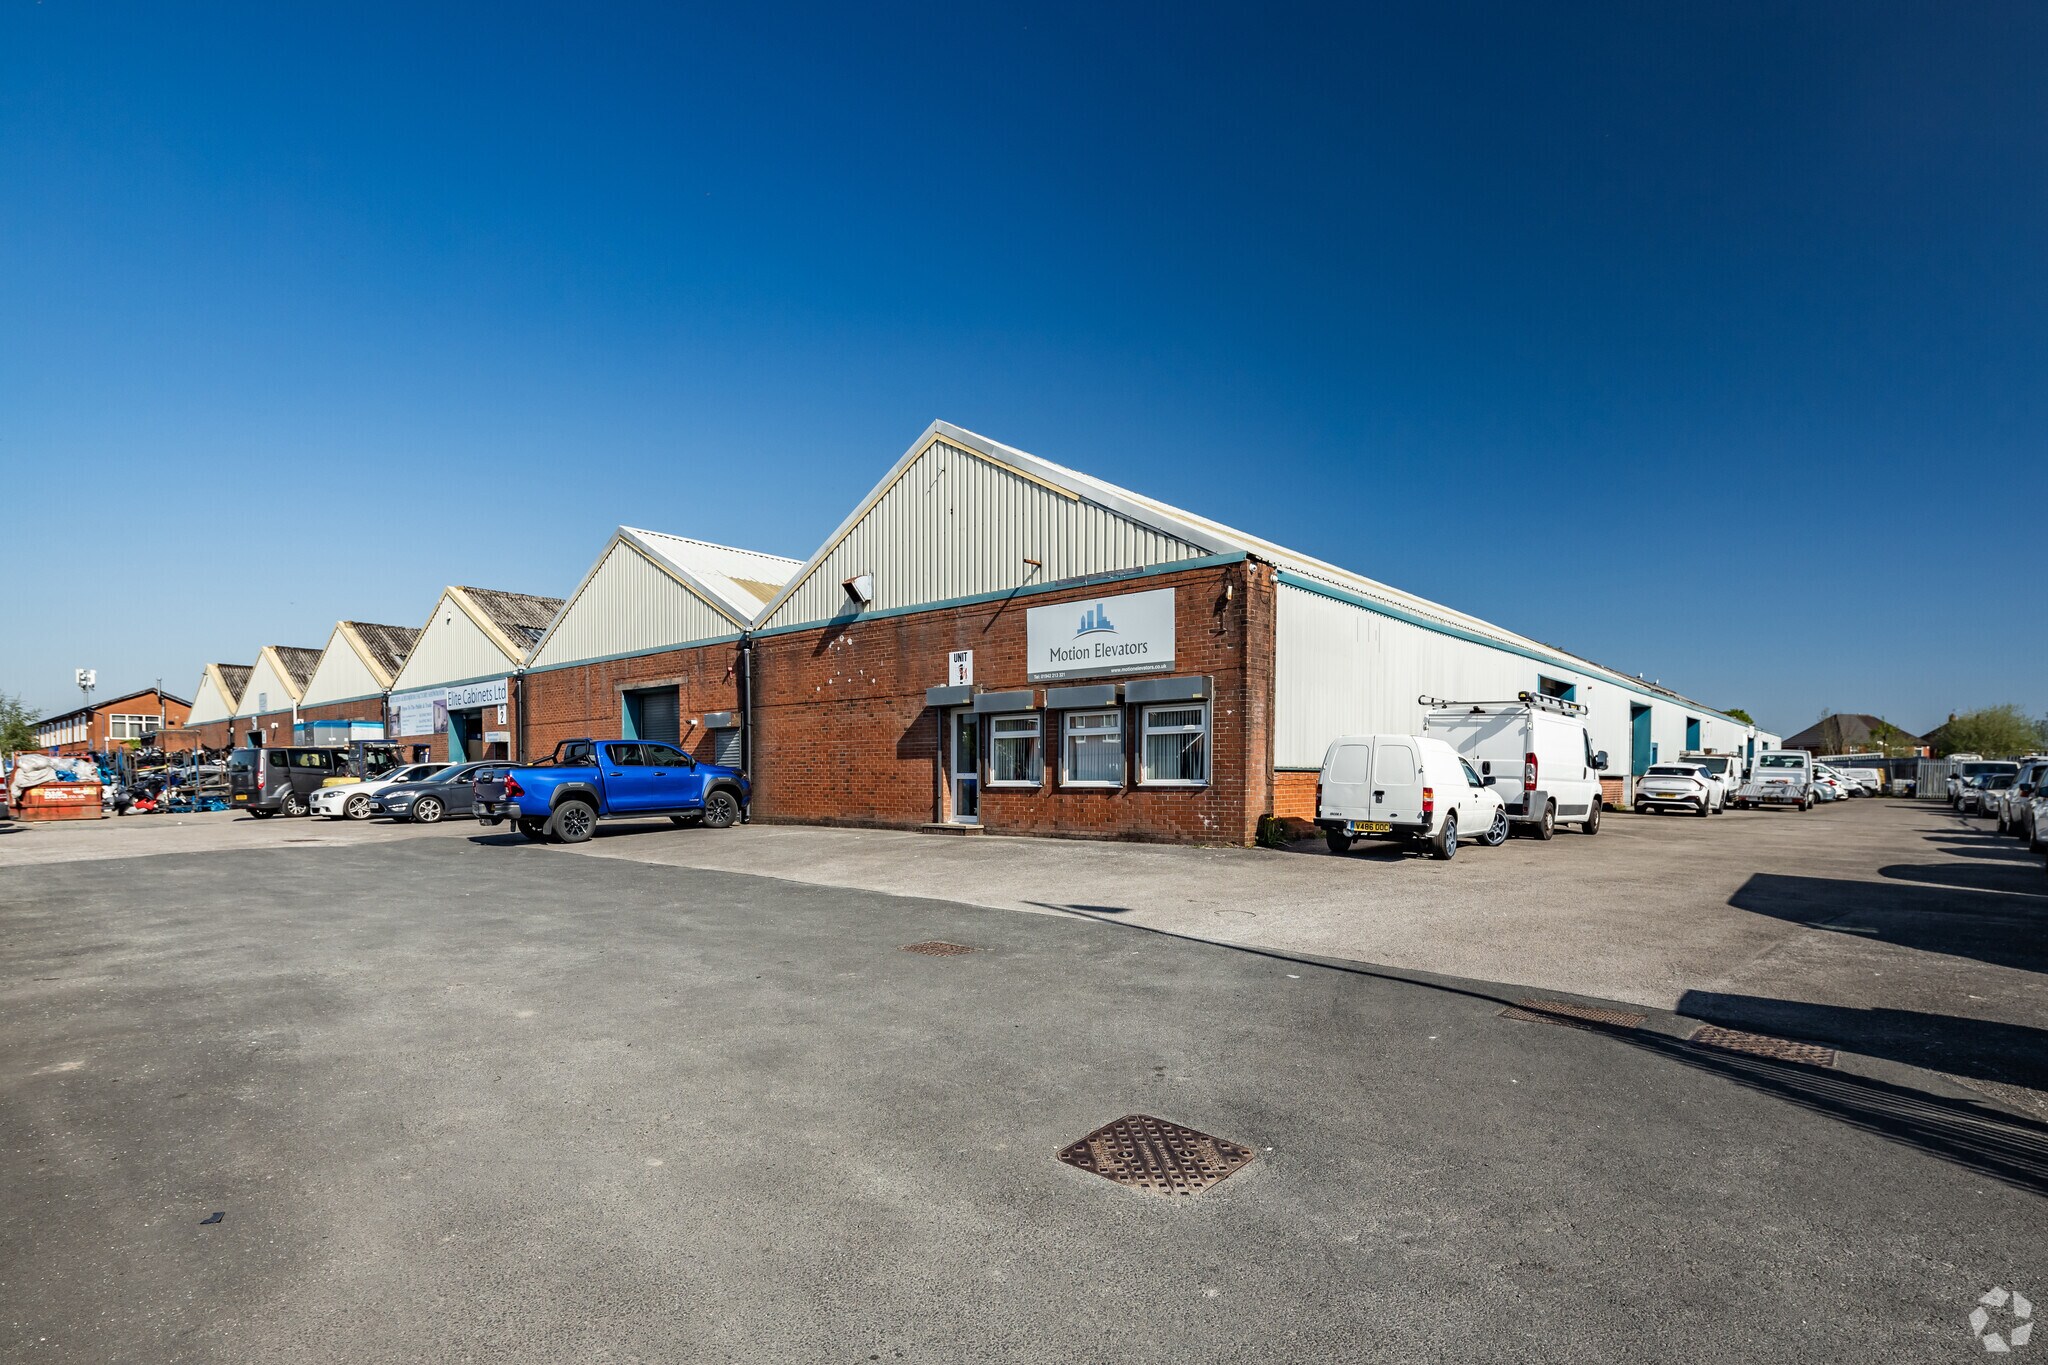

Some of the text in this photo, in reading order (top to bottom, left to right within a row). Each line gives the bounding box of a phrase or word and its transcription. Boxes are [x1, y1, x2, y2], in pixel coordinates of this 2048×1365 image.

[953, 652, 968, 663] UNIT
[1050, 642, 1148, 662] Motion Elevators
[1110, 664, 1167, 673] www.motionelevators.co.uk
[448, 691, 462, 706] Elite
[462, 688, 493, 705] Cabinets
[494, 683, 506, 701] Ltd
[1355, 823, 1374, 831] V486
